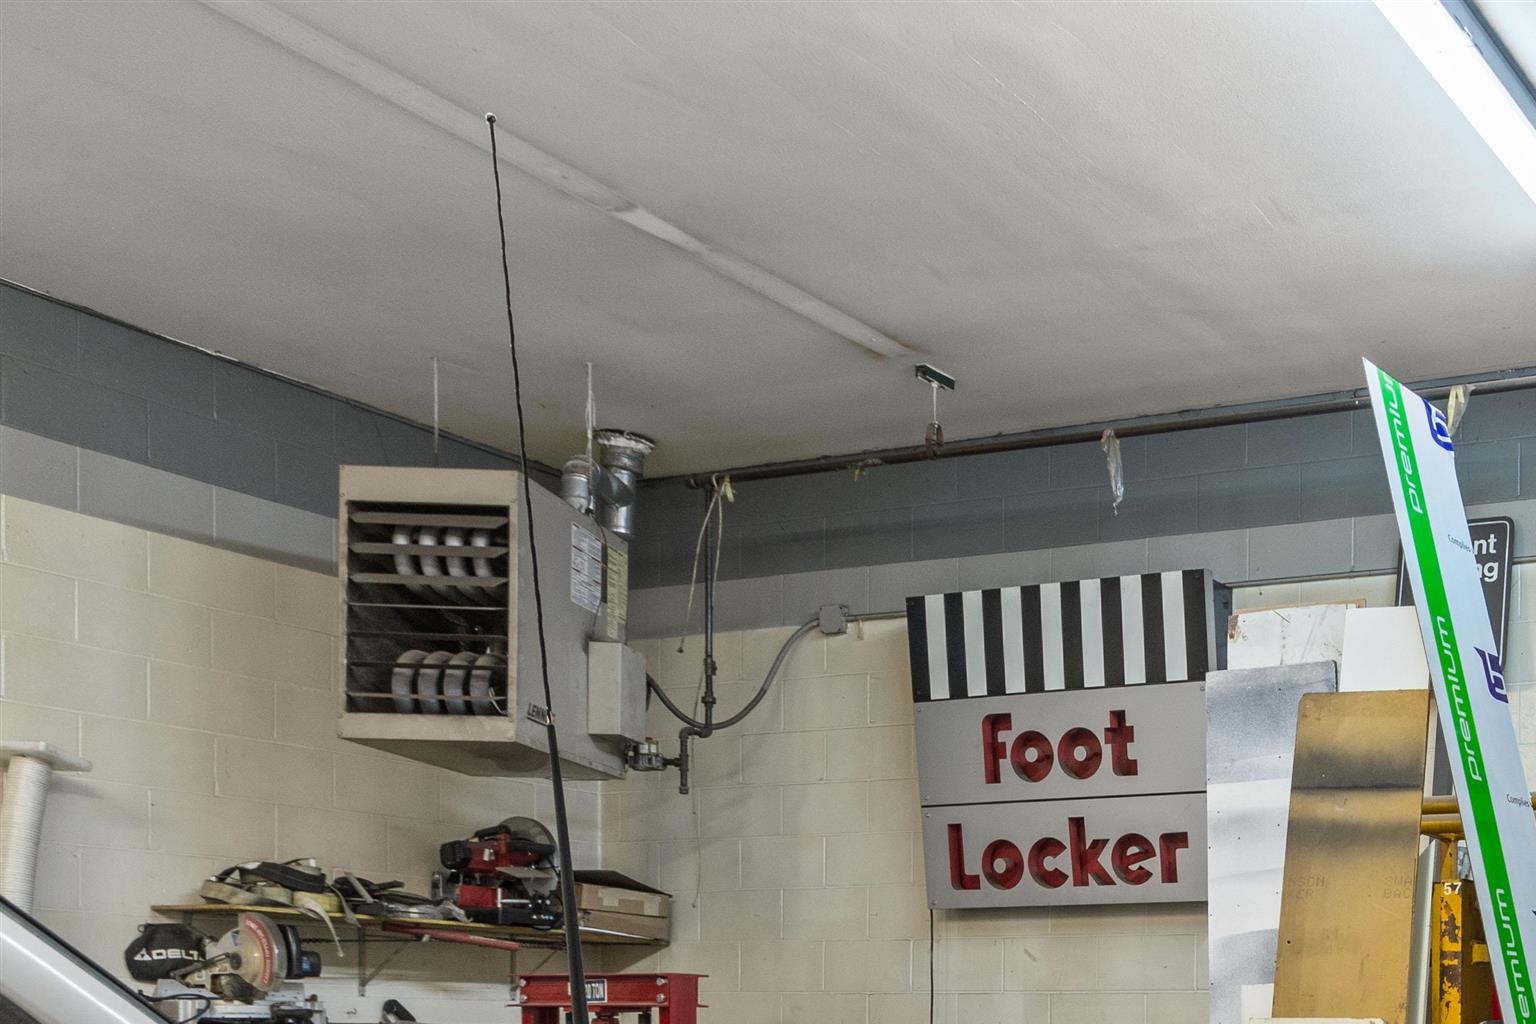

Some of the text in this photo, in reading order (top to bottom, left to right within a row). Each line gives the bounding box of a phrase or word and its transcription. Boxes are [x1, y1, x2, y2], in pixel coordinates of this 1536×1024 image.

[1436, 615, 1483, 782] premium
[946, 816, 1189, 892] Locker
[1443, 881, 1462, 896] 57
[152, 948, 204, 961] DELT
